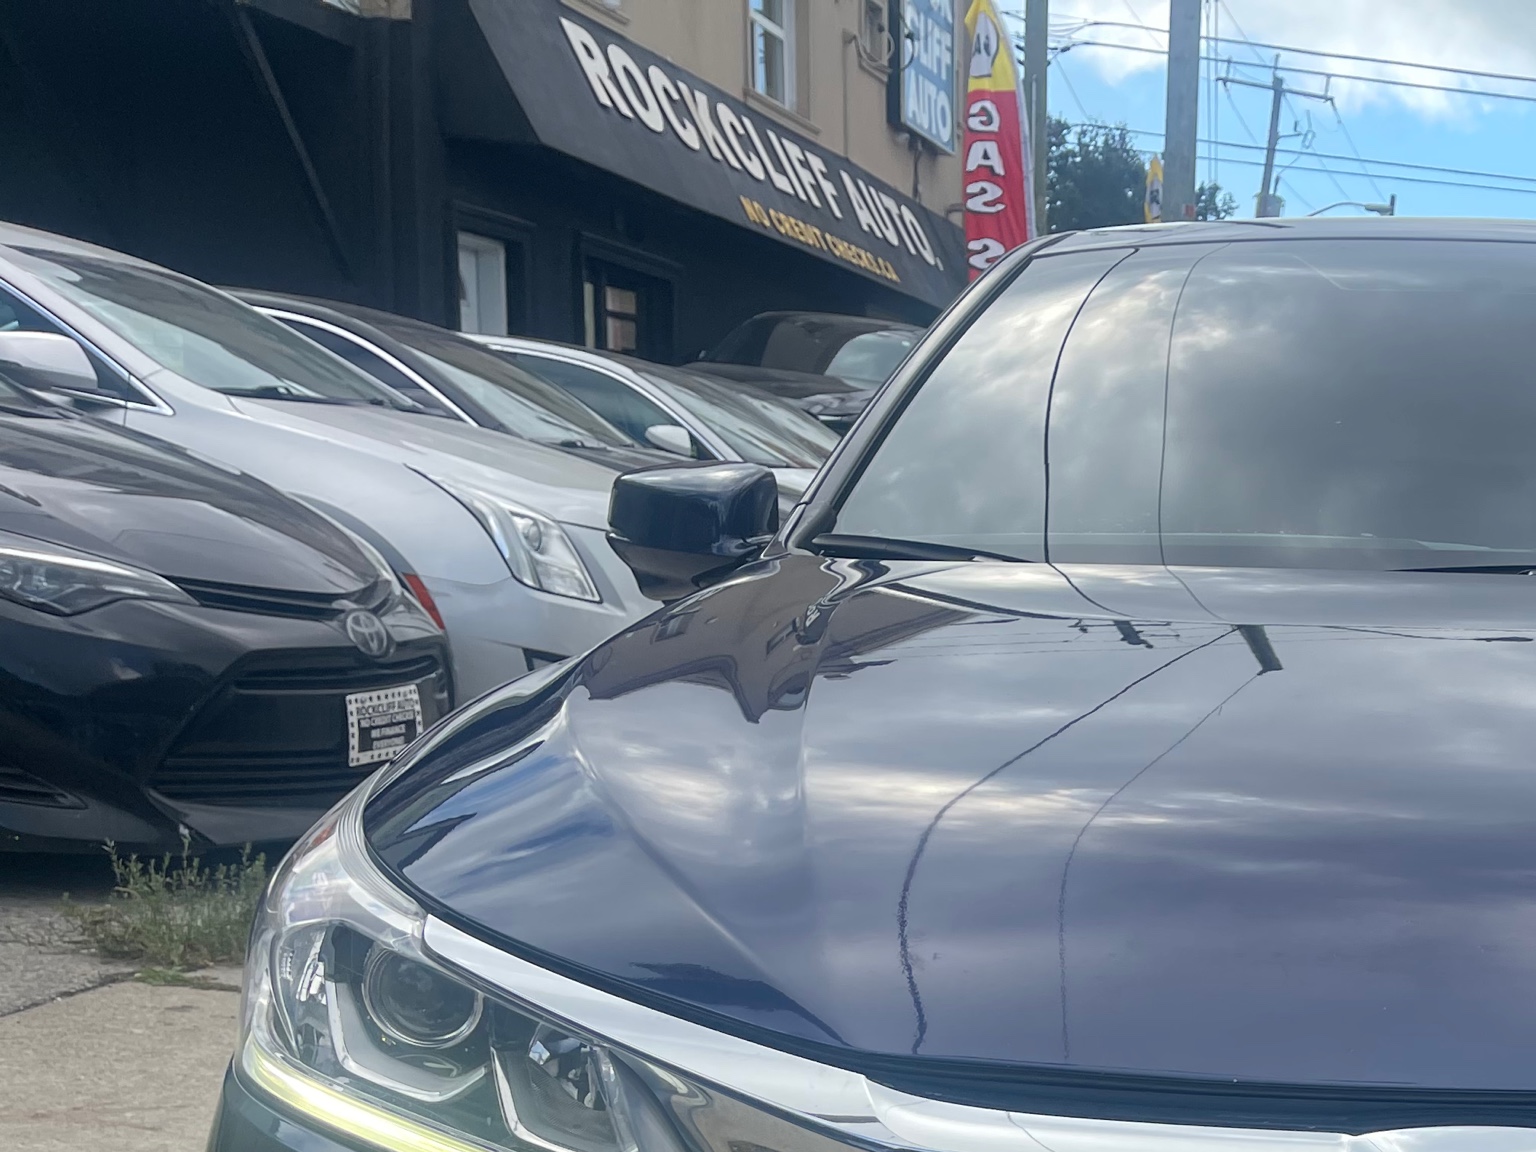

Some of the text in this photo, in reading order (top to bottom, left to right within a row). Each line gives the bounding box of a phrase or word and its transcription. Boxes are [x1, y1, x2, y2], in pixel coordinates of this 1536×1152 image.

[559, 16, 843, 219] ROCKCLIFF
[908, 69, 951, 143] AUTO
[740, 195, 771, 227] NO
